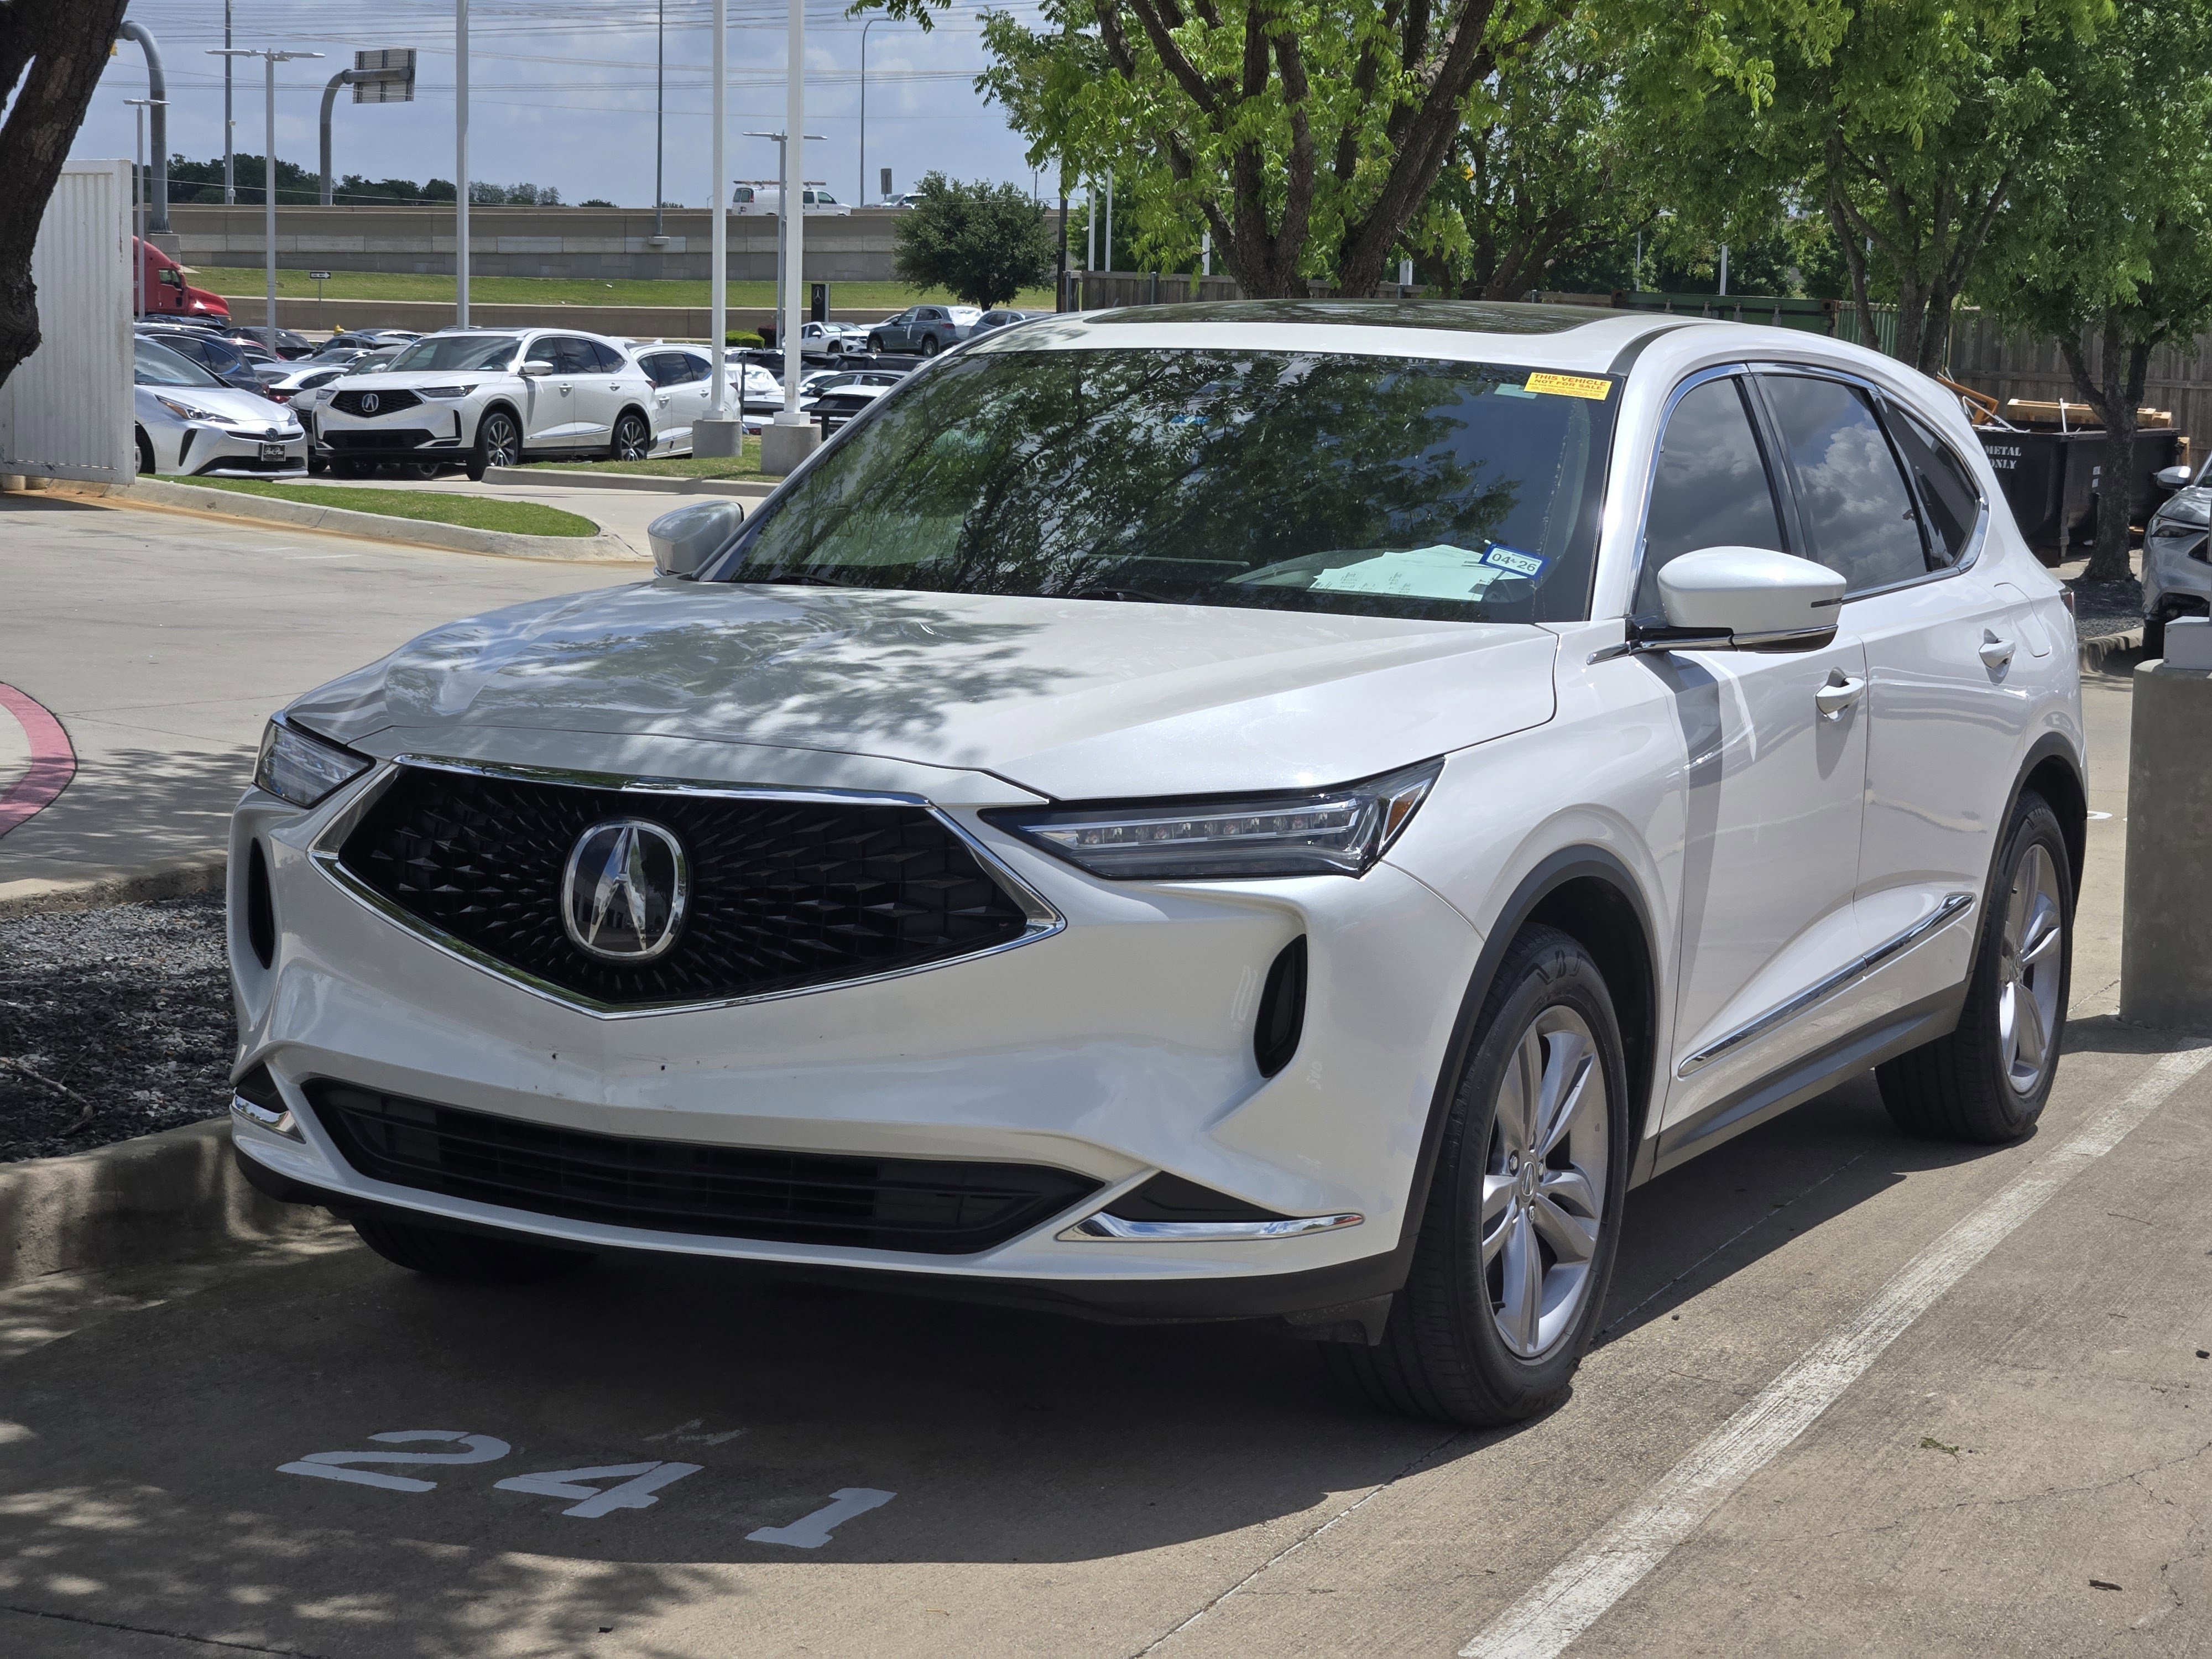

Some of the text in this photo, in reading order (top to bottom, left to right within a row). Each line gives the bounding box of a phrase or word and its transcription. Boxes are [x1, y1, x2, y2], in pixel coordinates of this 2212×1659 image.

[1562, 377, 1606, 386] VEHICLE
[1985, 445, 2022, 456] METAL
[1989, 458, 2017, 469] ONLY
[1492, 553, 1511, 564] 04
[1516, 560, 1537, 571] 26
